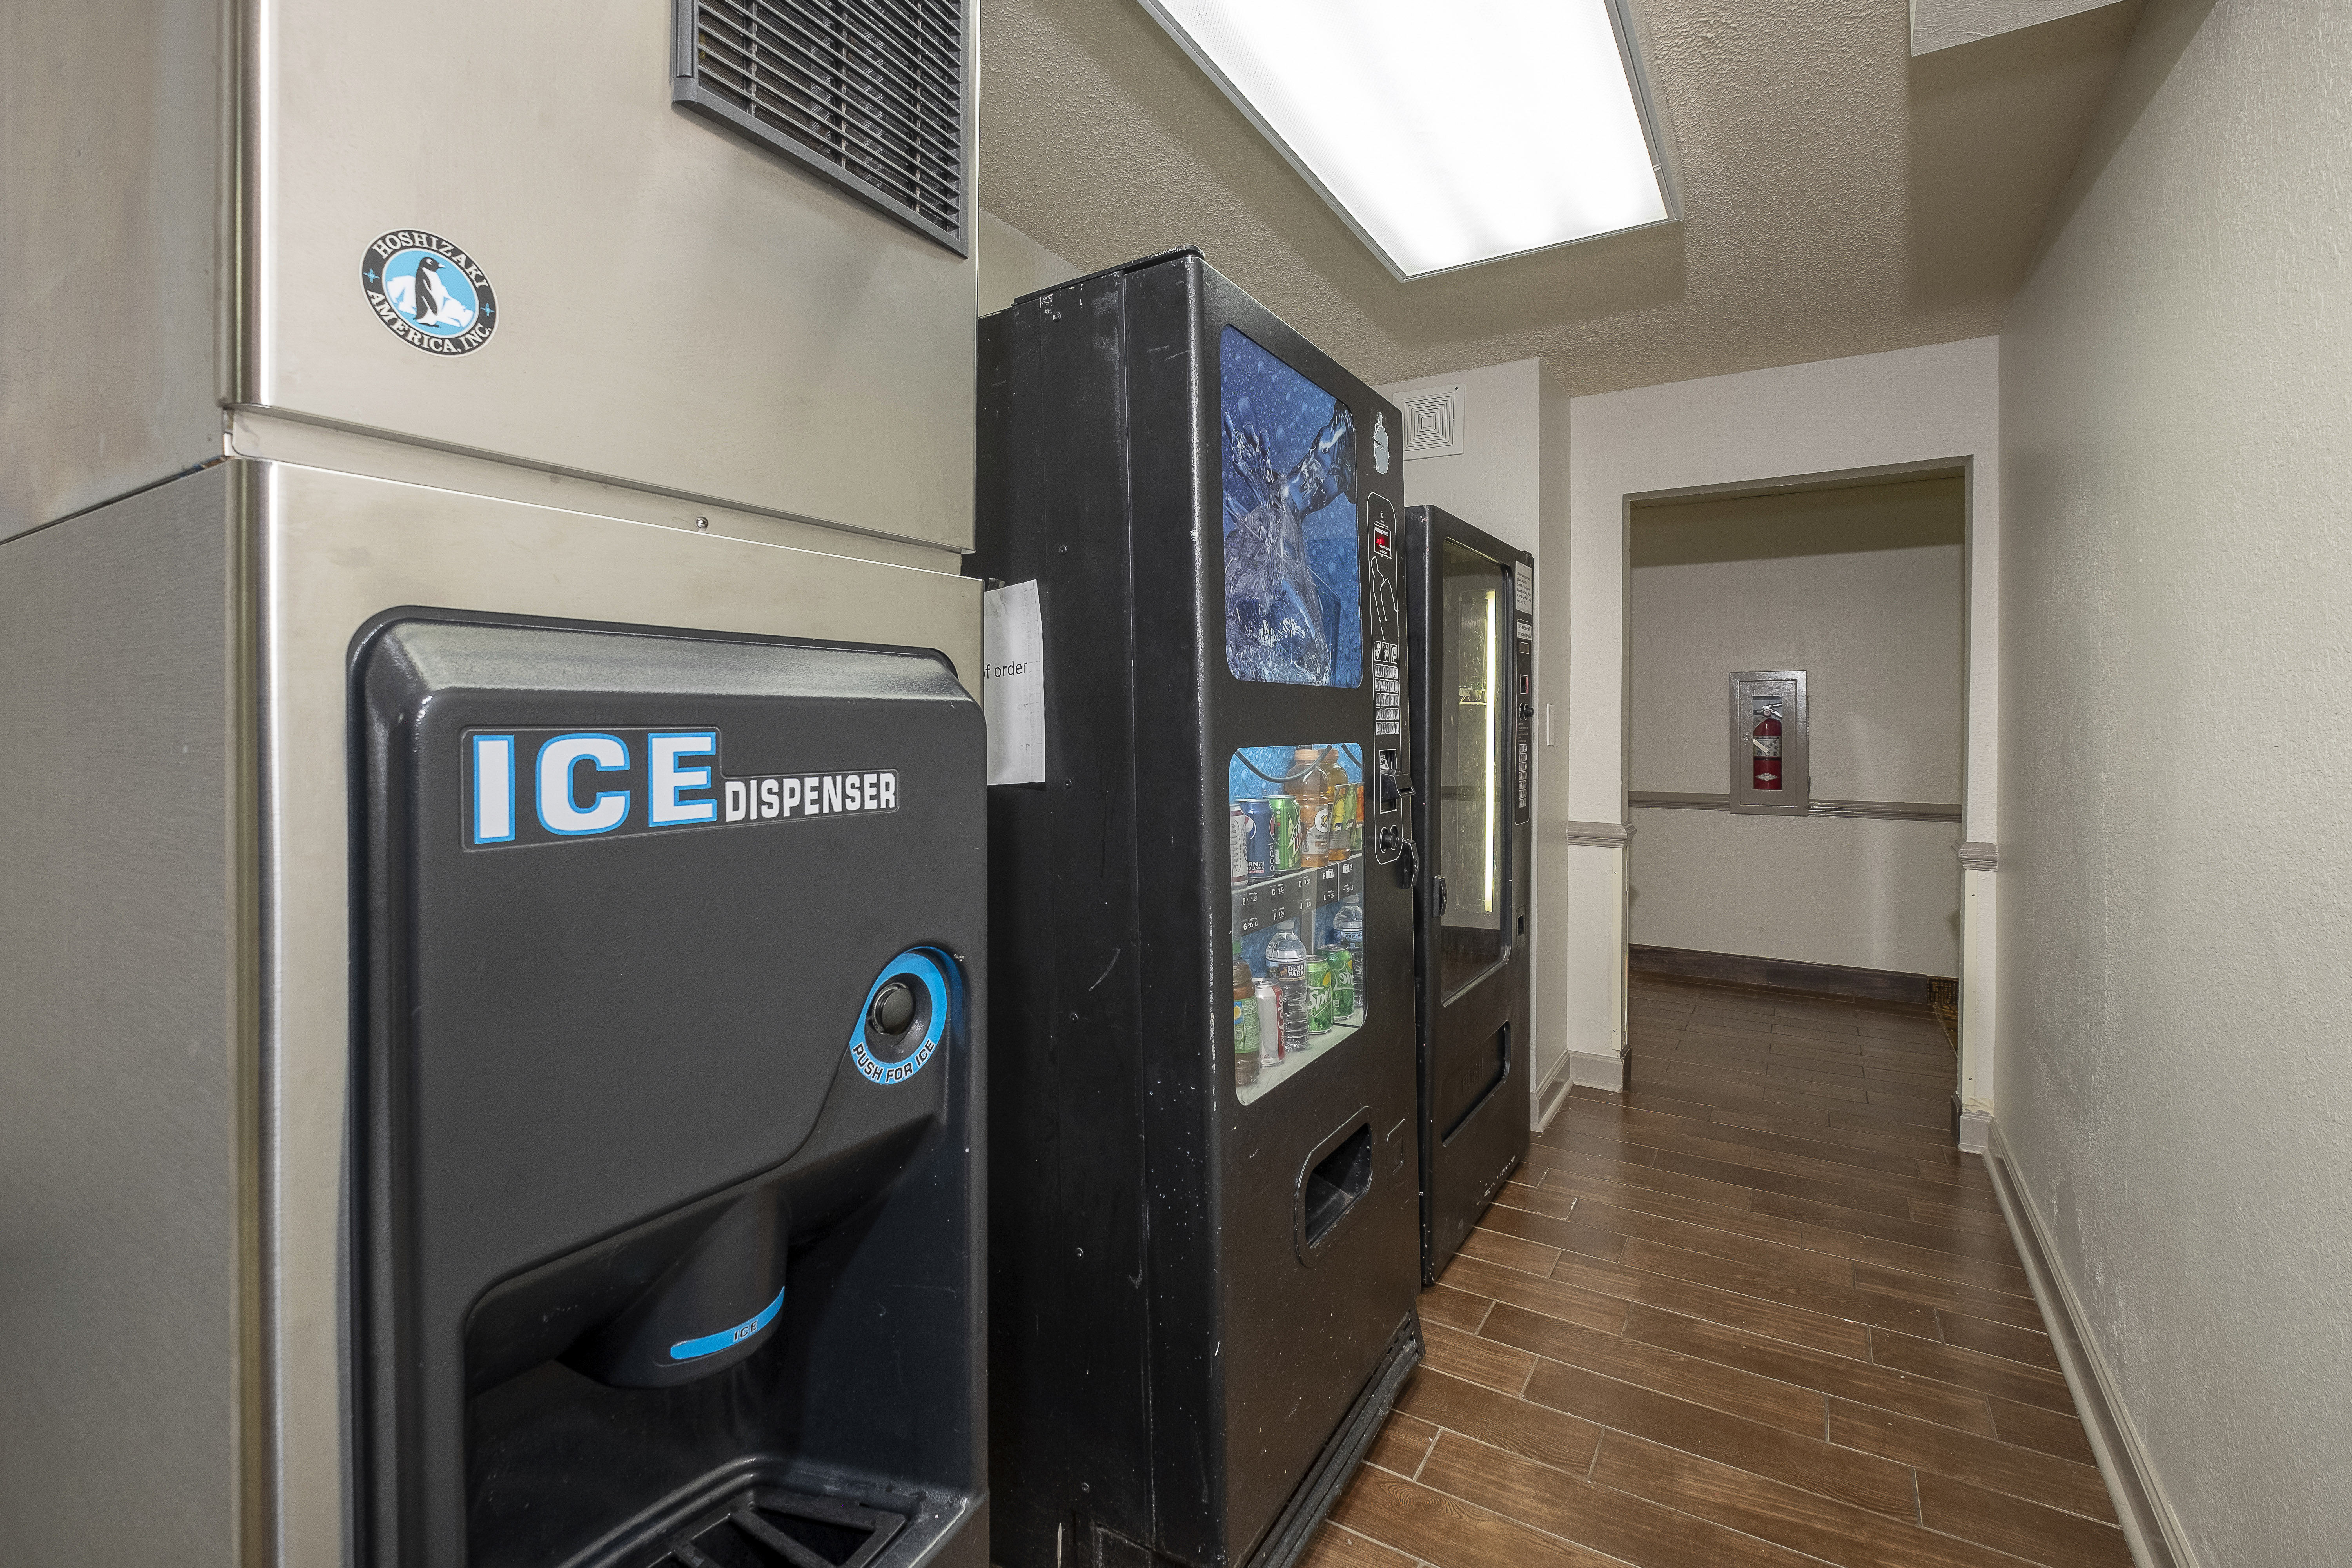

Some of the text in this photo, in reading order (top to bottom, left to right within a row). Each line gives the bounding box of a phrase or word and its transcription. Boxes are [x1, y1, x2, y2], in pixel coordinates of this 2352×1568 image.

[372, 232, 489, 288] HOSHIZAKI
[367, 289, 492, 353] AMERICA, INC.
[984, 660, 1028, 679] f order
[473, 731, 897, 844] ICE DISPENSER
[853, 1039, 935, 1082] PUSH FOR ICE
[1461, 1057, 1483, 1097] PUSH
[734, 1319, 758, 1342] ICE
